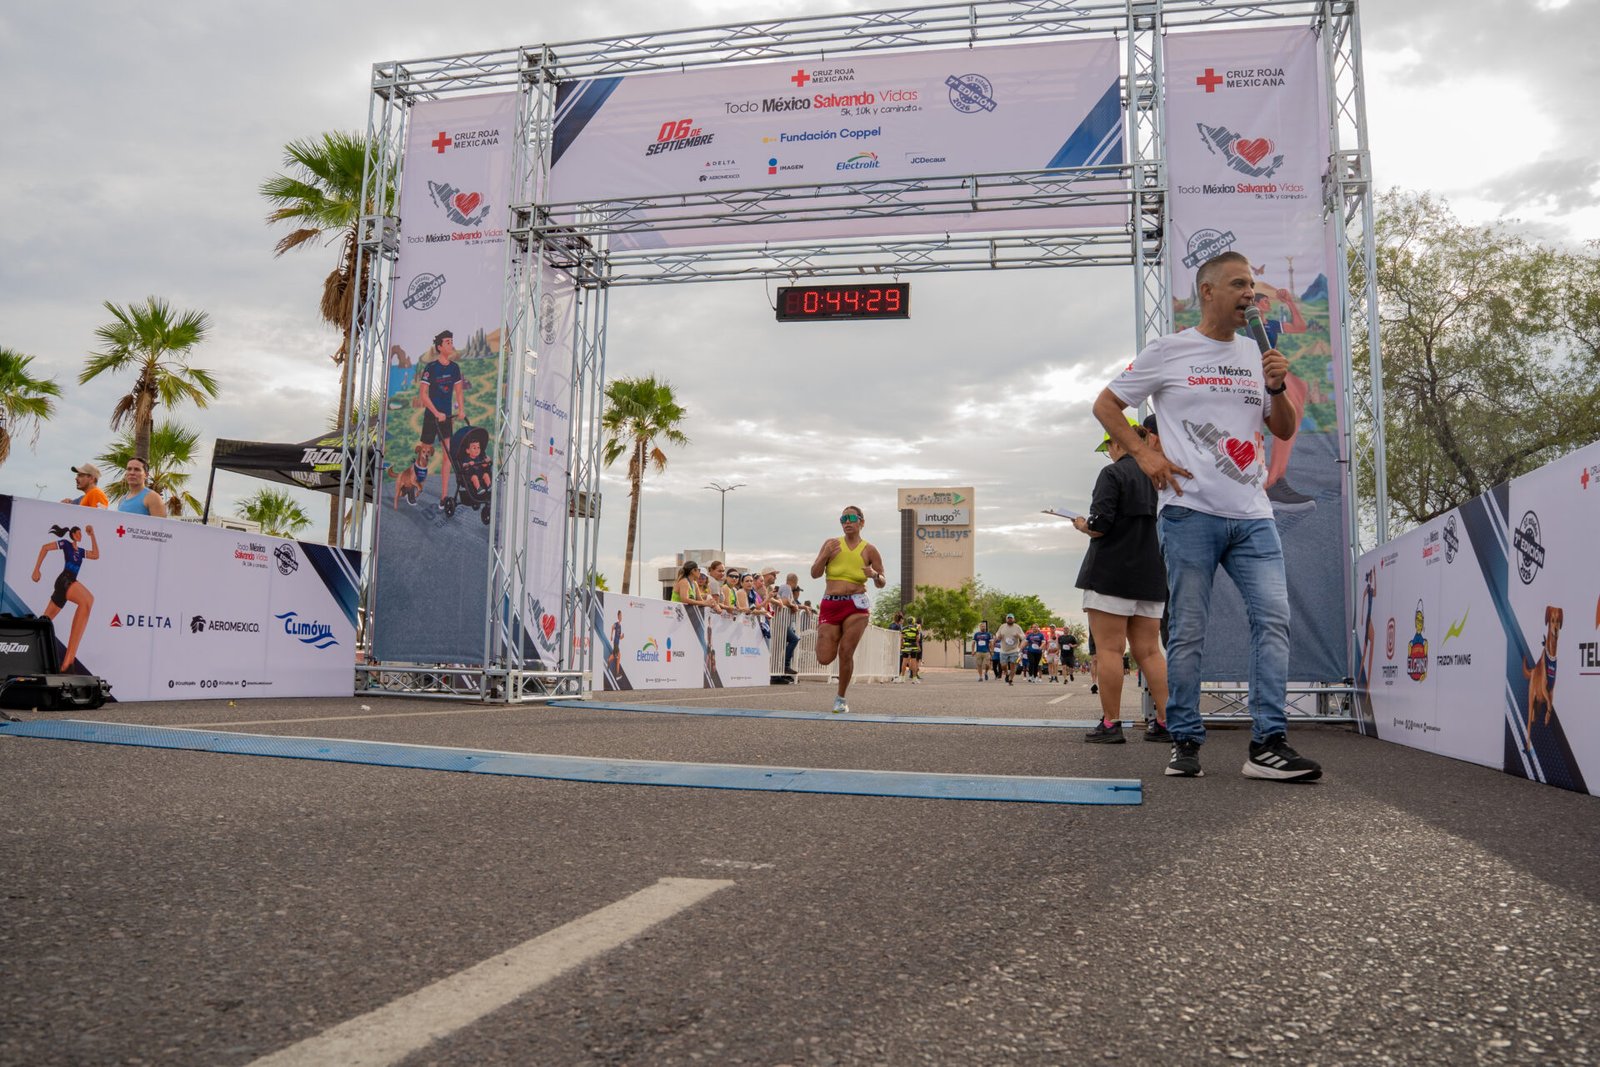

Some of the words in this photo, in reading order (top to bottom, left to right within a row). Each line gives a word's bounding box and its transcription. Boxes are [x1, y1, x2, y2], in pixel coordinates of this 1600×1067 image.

[835, 68, 855, 76] ROJA
[1226, 69, 1254, 79] CRUZ
[1257, 68, 1285, 77] ROJA
[812, 74, 855, 83] MEXICANA
[1226, 78, 1286, 88] MEXICANA
[725, 101, 758, 114] Todo
[762, 96, 811, 113] México
[814, 91, 875, 109] Salvando
[879, 88, 918, 102] Vidas
[958, 84, 995, 111] EDICIÓN
[953, 98, 971, 111] 2026
[856, 106, 871, 116] 10k
[455, 132, 476, 142] CRUZ
[478, 130, 499, 139] ROJA
[657, 118, 694, 143] 06
[690, 127, 703, 136] DE
[780, 129, 837, 143] Fundación
[839, 126, 881, 141] Coppel
[454, 138, 499, 149] MEXICANA
[645, 133, 715, 156] SEPTIEMBRE
[836, 158, 880, 171] Electrolit
[910, 156, 946, 165] JCDecaux
[780, 163, 804, 171] IMAGEN
[1178, 185, 1201, 195] Todo
[1202, 183, 1236, 195] México
[1237, 183, 1277, 194] Salvando
[1279, 183, 1304, 192] Vidas
[407, 235, 425, 244] Todo
[425, 233, 451, 244] México
[451, 230, 482, 242] Salvando
[483, 229, 504, 237] Vidas
[1196, 234, 1235, 261] EDICIÓN
[413, 277, 444, 302] EDICIÓN
[422, 296, 437, 308] 2026
[804, 290, 900, 313] 0:44:29
[1189, 365, 1217, 374] Todo
[1218, 365, 1252, 377] México
[1187, 375, 1233, 386] Salvando
[925, 513, 955, 524] intugo
[152, 531, 173, 540] MEXICANA
[916, 527, 969, 542] Qualisys
[1520, 539, 1544, 567] EDICIÓN
[127, 614, 172, 629] DELTA
